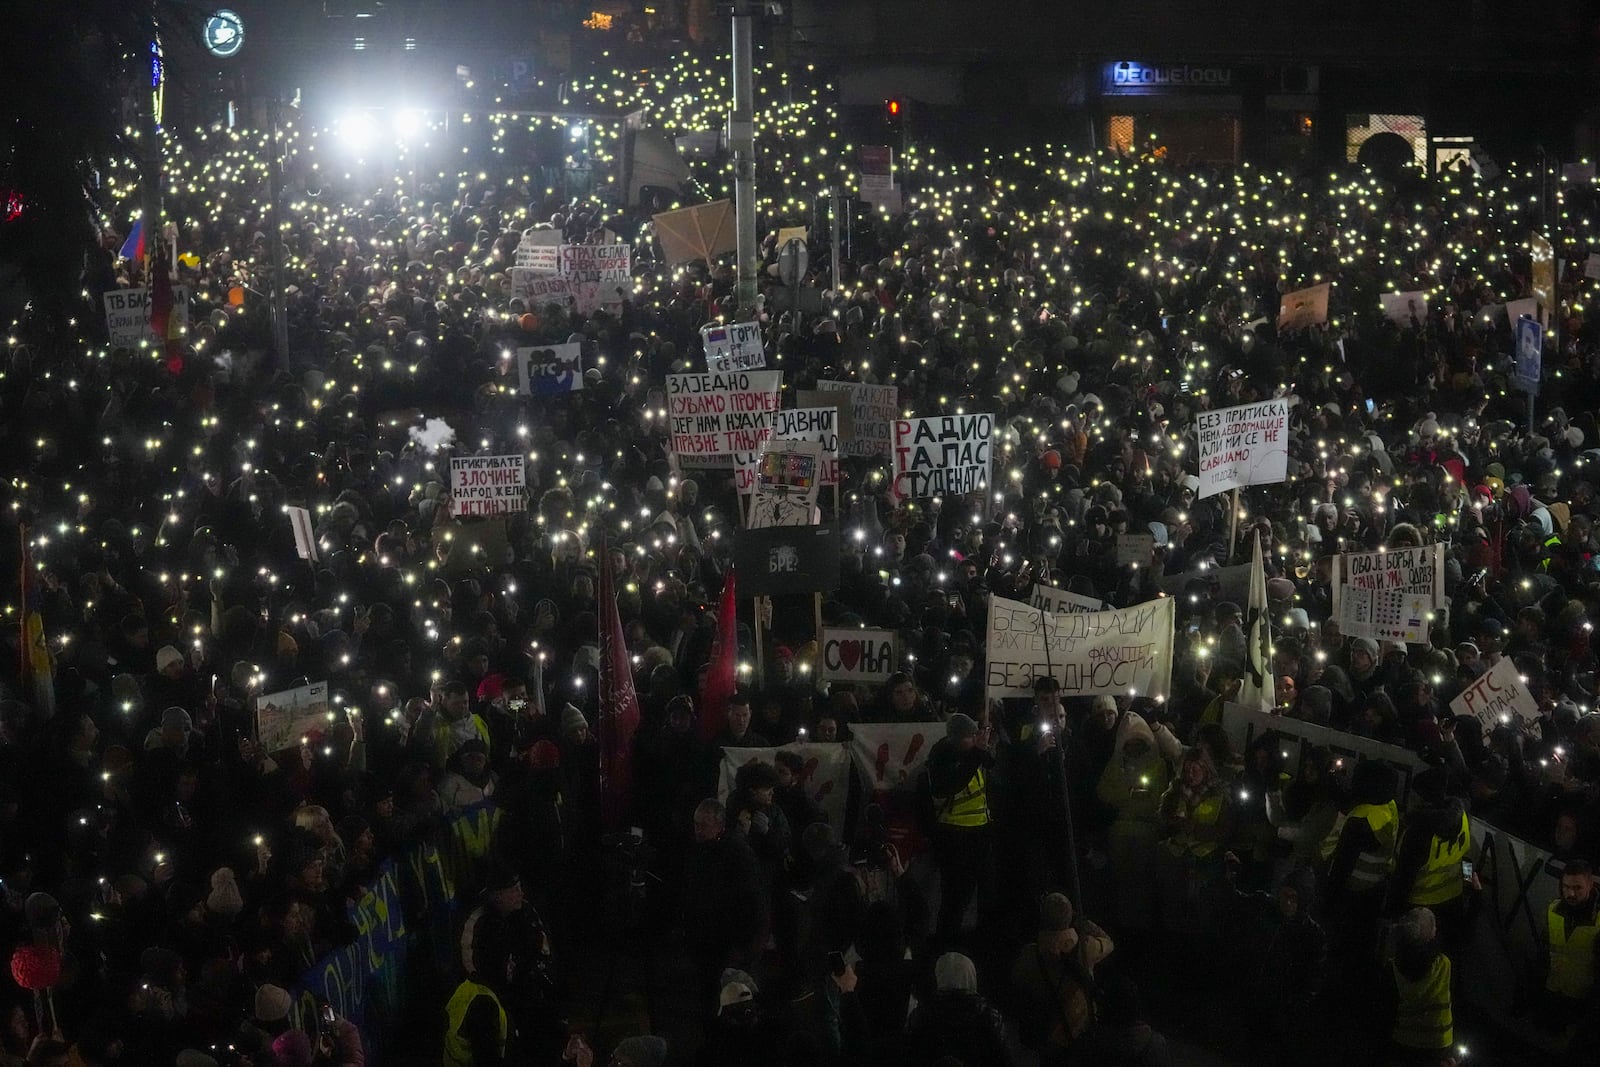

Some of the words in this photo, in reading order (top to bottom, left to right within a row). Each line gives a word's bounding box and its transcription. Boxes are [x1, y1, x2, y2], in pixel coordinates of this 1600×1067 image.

[563, 246, 597, 259] СТРАХ
[107, 294, 125, 310] ТВ
[730, 324, 761, 344] ГОРИ
[716, 346, 726, 359] А
[716, 358, 730, 372] СЕ
[734, 352, 764, 370] ЧЕШЛА
[530, 362, 558, 377] РТС
[670, 373, 749, 394] ЗАЈЕДНО
[670, 394, 726, 415] КУВАМО
[672, 417, 694, 434] ЈЕР
[696, 414, 721, 433] НАМ
[726, 411, 778, 430] НУДИТЕ
[777, 410, 838, 436] ЈАВНОГ
[1199, 413, 1221, 431] БЕЗ
[1225, 404, 1286, 423] ПРИТИСКА
[895, 414, 992, 446] РАДИО
[1200, 430, 1221, 443] НЕМА
[673, 434, 720, 453] ПРАЗНЕ
[1201, 438, 1223, 458] АЛИ
[1225, 434, 1241, 449] МИ
[1244, 431, 1258, 446] СЕ
[1264, 429, 1279, 443] НЕ
[452, 456, 523, 470] ПРИКРИВАТЕ
[895, 441, 988, 471] ТАЛАС
[1200, 448, 1250, 472] САВИЈАМО
[460, 468, 521, 487] ЗЛОЧИНЕ
[893, 465, 987, 499] СТУДЕНАТА
[454, 487, 492, 499] НАРОД
[1352, 554, 1372, 576] ОВО
[1372, 554, 1383, 571] ЈЕ
[1386, 550, 1414, 570] БОРБА
[1408, 565, 1432, 585] ОДРАЗ
[993, 604, 1156, 641] БЕЗБЕДЊАЦИ
[1088, 642, 1156, 662] ФАКУЛТЕТ
[1462, 671, 1502, 714] РТС
